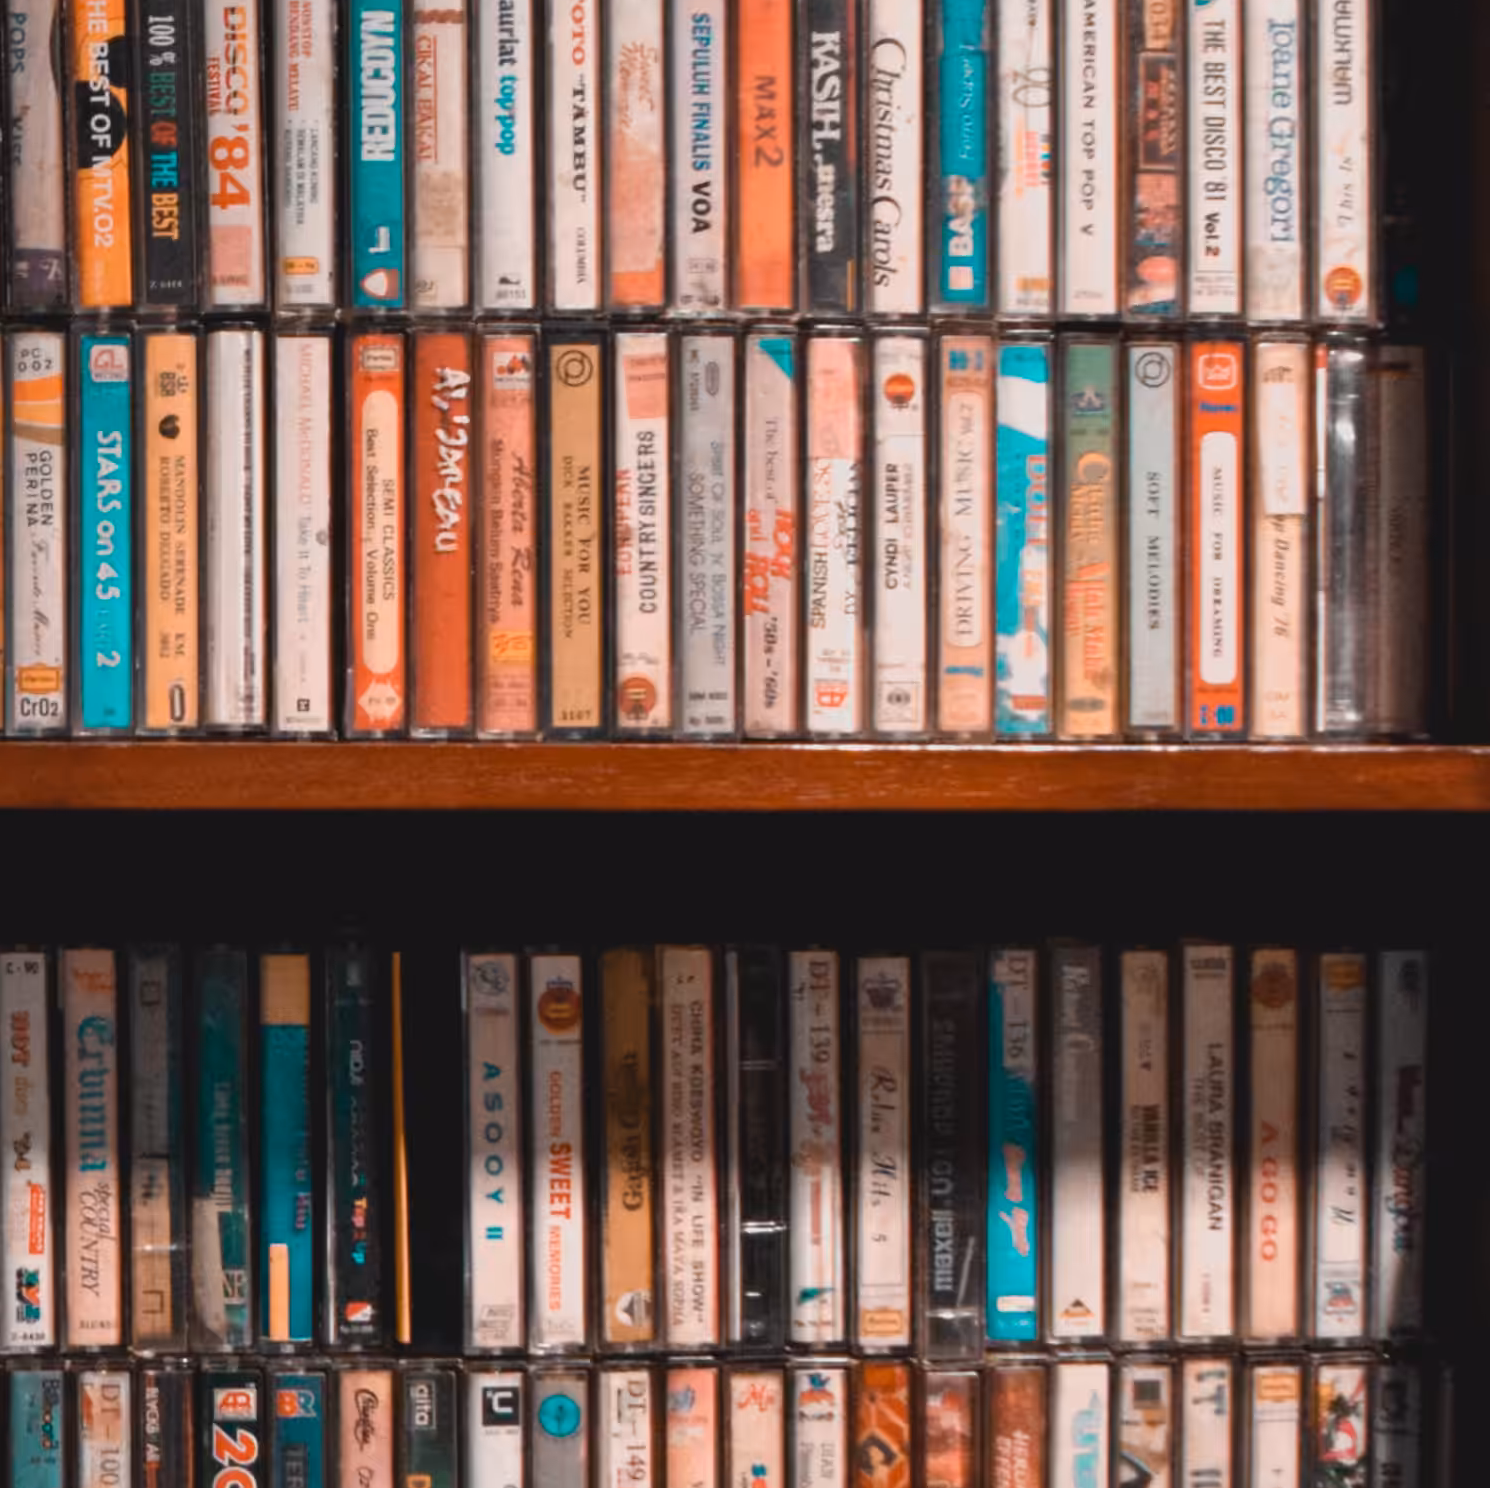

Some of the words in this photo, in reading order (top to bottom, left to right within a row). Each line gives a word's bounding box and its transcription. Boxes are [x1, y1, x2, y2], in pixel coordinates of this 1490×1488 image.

[150, 15, 179, 46] 100
[692, 13, 712, 96] SEPULUH
[1202, 20, 1227, 53] THE
[89, 42, 110, 107] BEST
[150, 72, 179, 116] BEST
[495, 75, 518, 109] top
[1202, 63, 1227, 109] BEST
[90, 113, 111, 149] OF
[150, 122, 179, 148] OF
[495, 114, 518, 156] pop
[692, 102, 712, 172] FINALIS
[871, 38, 907, 192] Christmas
[1202, 116, 1227, 171] DISCO
[153, 152, 179, 188] THE
[153, 193, 179, 241] BEST
[692, 181, 712, 235] VOA
[871, 195, 907, 288] Carols
[26, 453, 39, 528] PERINA
[40, 450, 53, 527] GOLDEN
[95, 430, 123, 512] STARS
[1146, 471, 1161, 519] SOFT
[96, 520, 116, 557] on
[95, 561, 121, 601] 45
[1146, 535, 1161, 631] MELODIES
[1260, 1120, 1279, 1146] A
[1260, 1157, 1279, 1204] GO
[1260, 1215, 1279, 1263] GO
